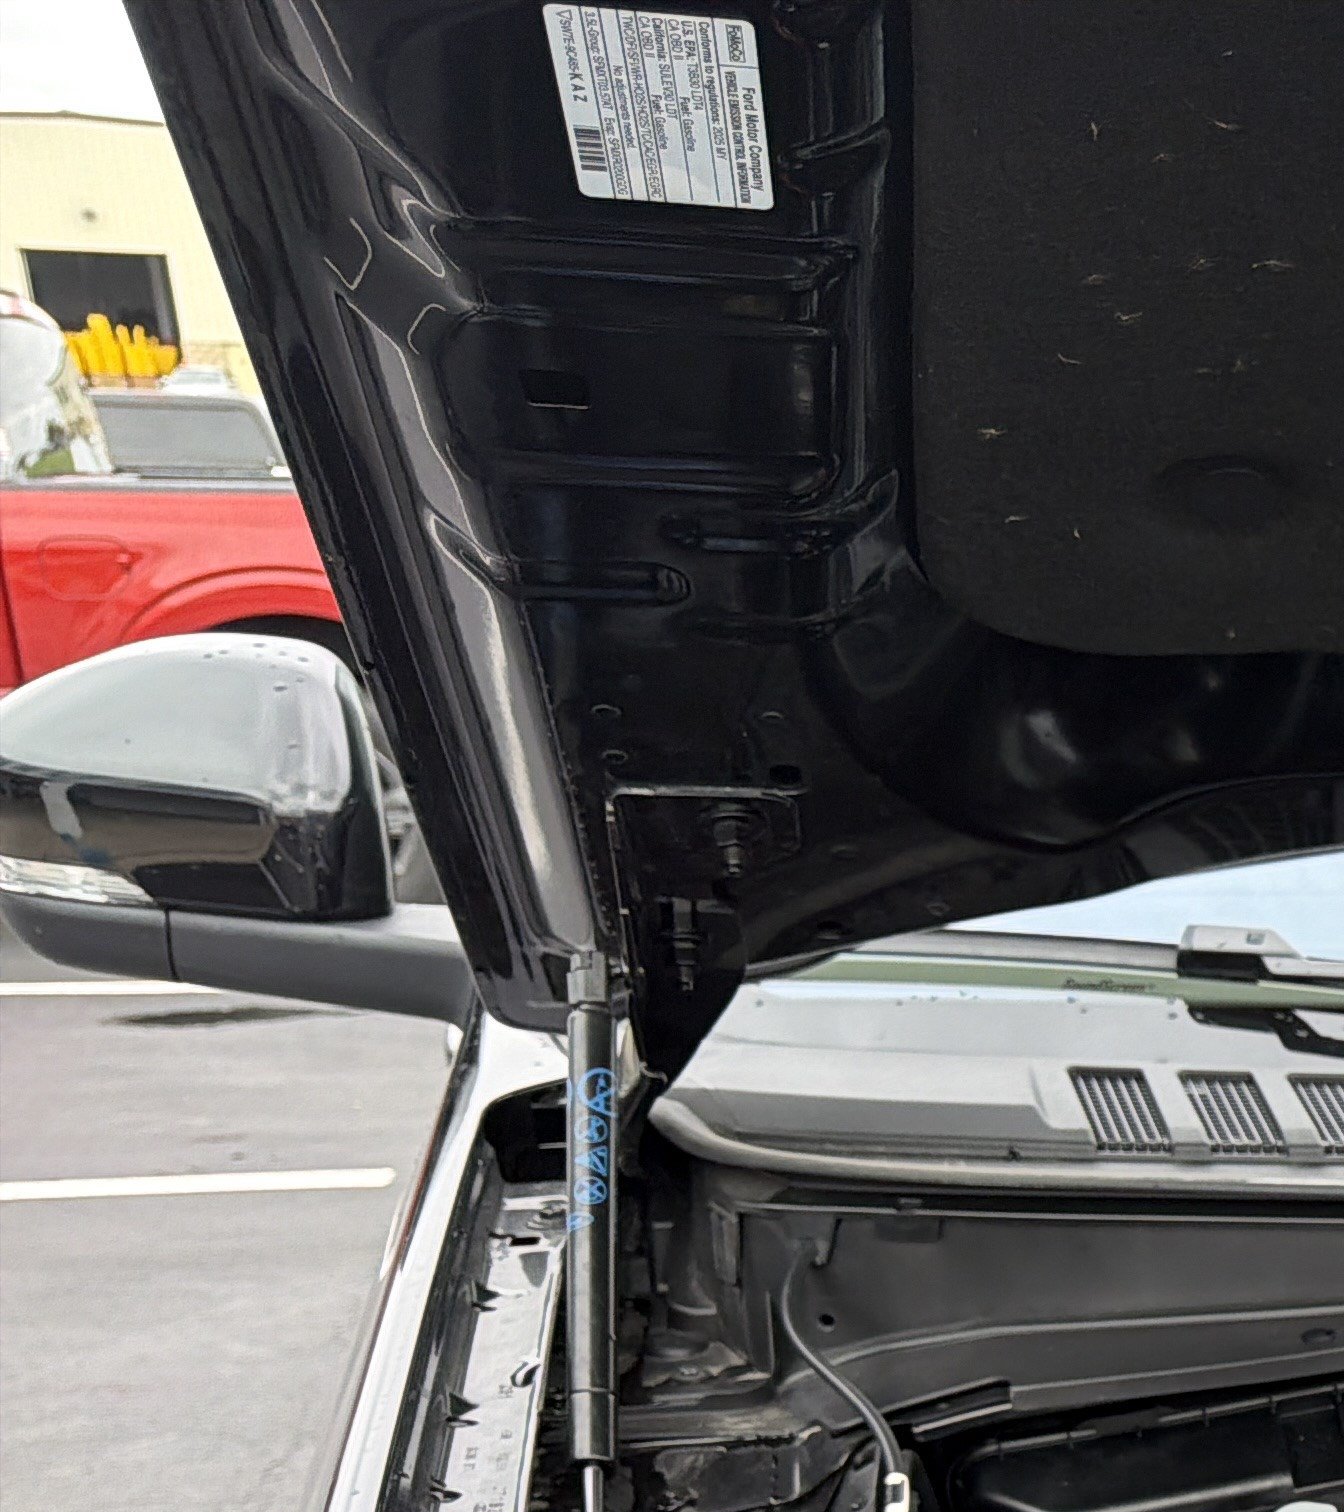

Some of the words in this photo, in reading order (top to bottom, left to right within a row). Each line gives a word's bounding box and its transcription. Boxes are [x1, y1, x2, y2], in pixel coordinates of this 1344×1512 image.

[650, 17, 669, 62] California:
[679, 20, 693, 37] U.S.
[697, 20, 714, 63] Conforms
[682, 39, 696, 61] EPA:
[611, 64, 624, 77] No
[637, 15, 650, 28] CA
[653, 116, 670, 150] Gasoline
[703, 64, 715, 74] to
[723, 70, 739, 98] VEHICLE
[611, 77, 632, 121] adjustments
[666, 18, 679, 32] CA
[681, 118, 698, 152] Gasoline
[702, 75, 722, 124] regulations:
[741, 86, 758, 111] Ford
[726, 98, 742, 130] EMISSION
[744, 113, 761, 143] Motor
[712, 126, 725, 145] 2025
[730, 131, 746, 160] CONTROL
[715, 146, 727, 160] MY
[745, 144, 767, 191] Company
[734, 161, 752, 204] INFORMATION
